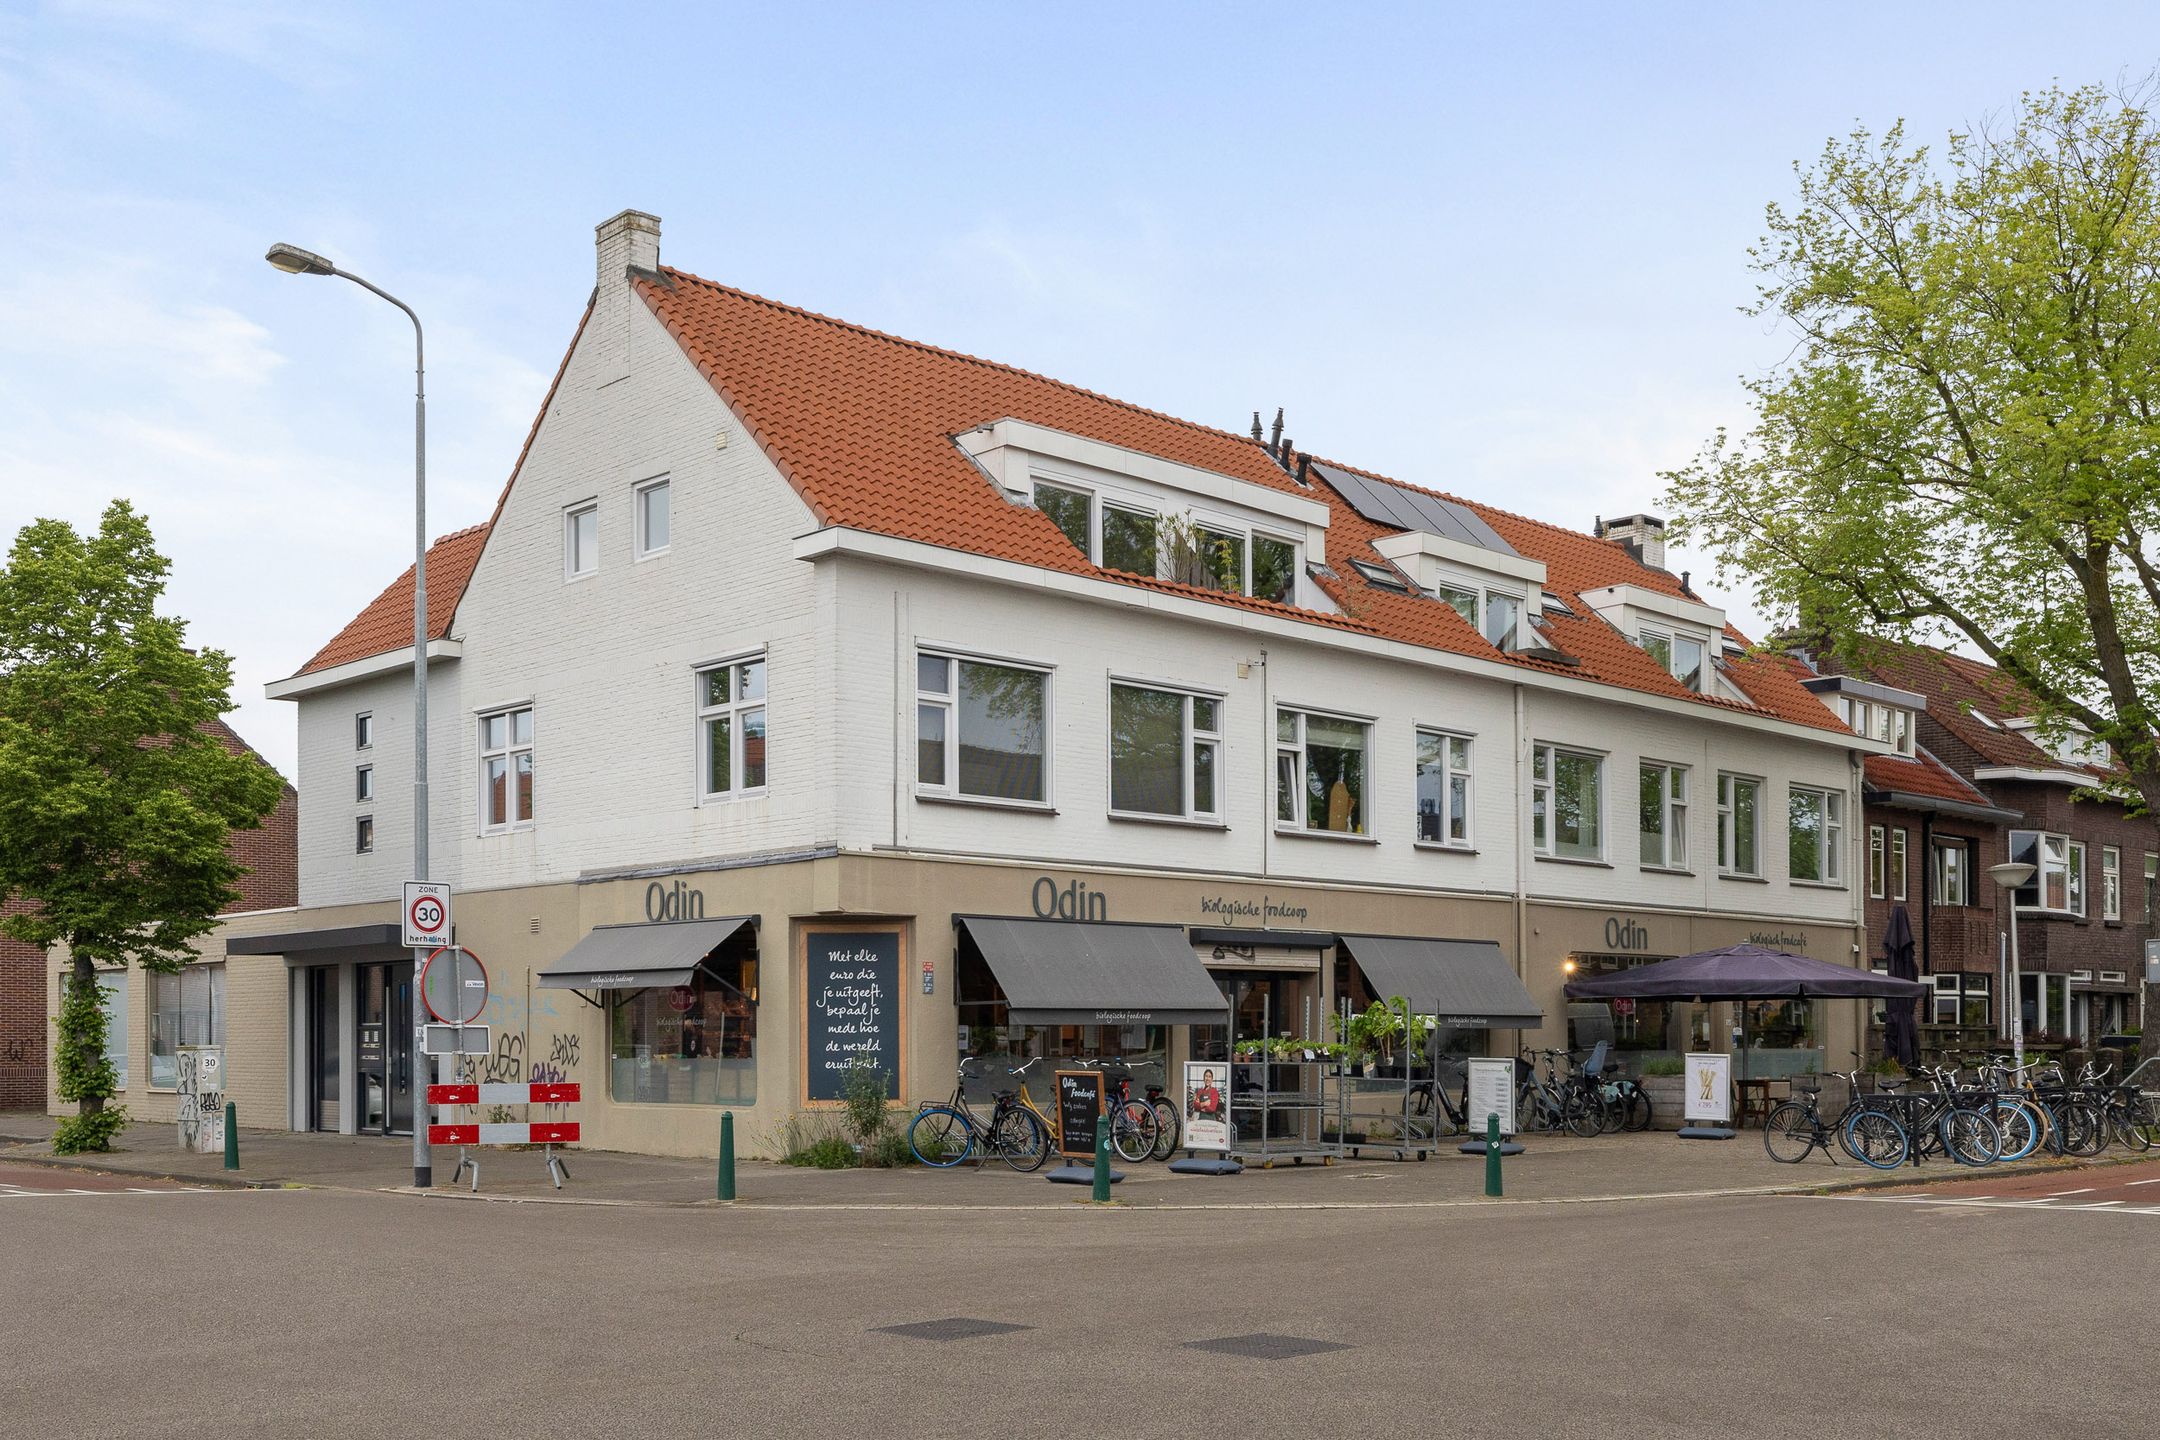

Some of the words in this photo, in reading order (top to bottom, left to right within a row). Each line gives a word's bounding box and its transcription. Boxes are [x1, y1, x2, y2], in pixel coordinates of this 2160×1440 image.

[418, 886, 438, 894] ZONE
[645, 880, 704, 922] Odin
[1032, 876, 1106, 921] Odin
[417, 907, 440, 922] 30
[1201, 896, 1260, 926] biologische
[1263, 895, 1307, 926] foodcoop
[409, 935, 447, 944] herhang
[1605, 917, 1648, 950] Odin
[828, 950, 852, 962] Met
[854, 949, 878, 962] elke
[829, 971, 853, 980] euro
[857, 968, 877, 980] die
[816, 986, 834, 1008] je
[835, 983, 884, 1007] uitgeeft,
[826, 1002, 868, 1019] bepaal
[863, 1003, 881, 1026] je
[1095, 1010, 1126, 1024] biologische
[1126, 1010, 1152, 1024] foodcoop
[828, 1022, 857, 1033] mede
[860, 1021, 880, 1033] hoe
[825, 1040, 841, 1052] de
[842, 1038, 882, 1052] wereld
[204, 1058, 216, 1067] 30
[1062, 1076, 1077, 1089] Odin
